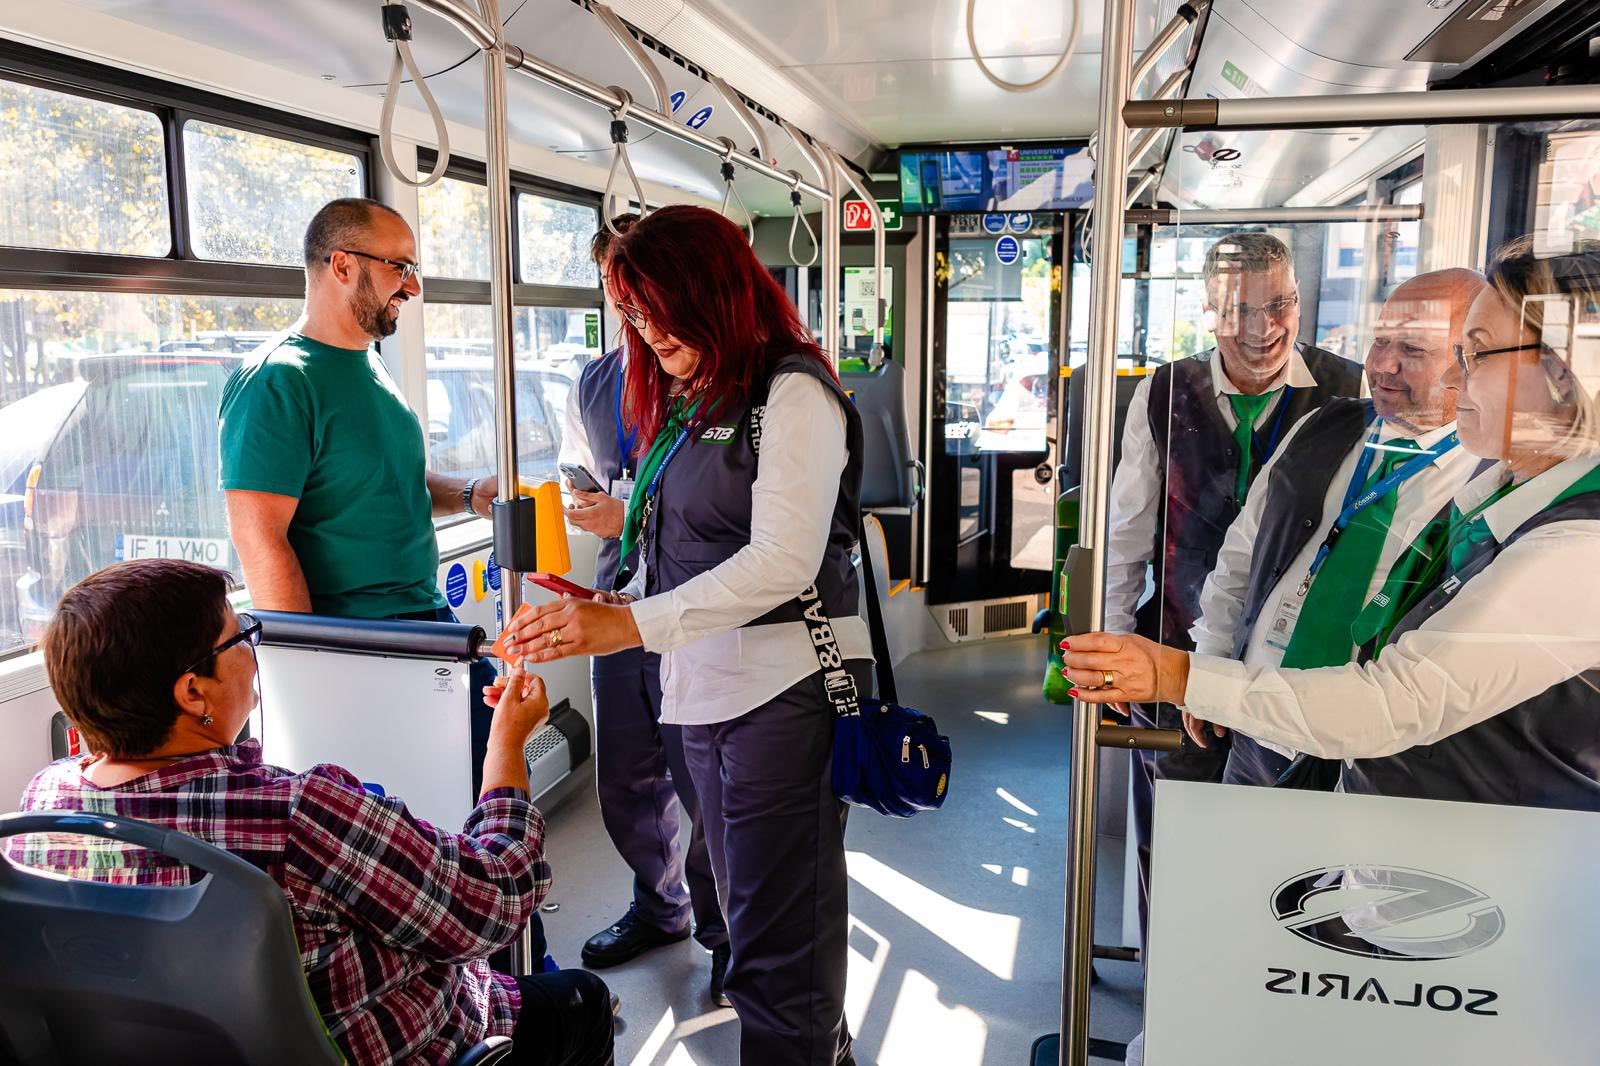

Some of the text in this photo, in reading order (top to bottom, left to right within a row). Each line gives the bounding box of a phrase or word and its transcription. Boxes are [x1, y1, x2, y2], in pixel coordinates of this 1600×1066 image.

[700, 426, 735, 440] STB
[131, 538, 218, 562] IF 11 YMO
